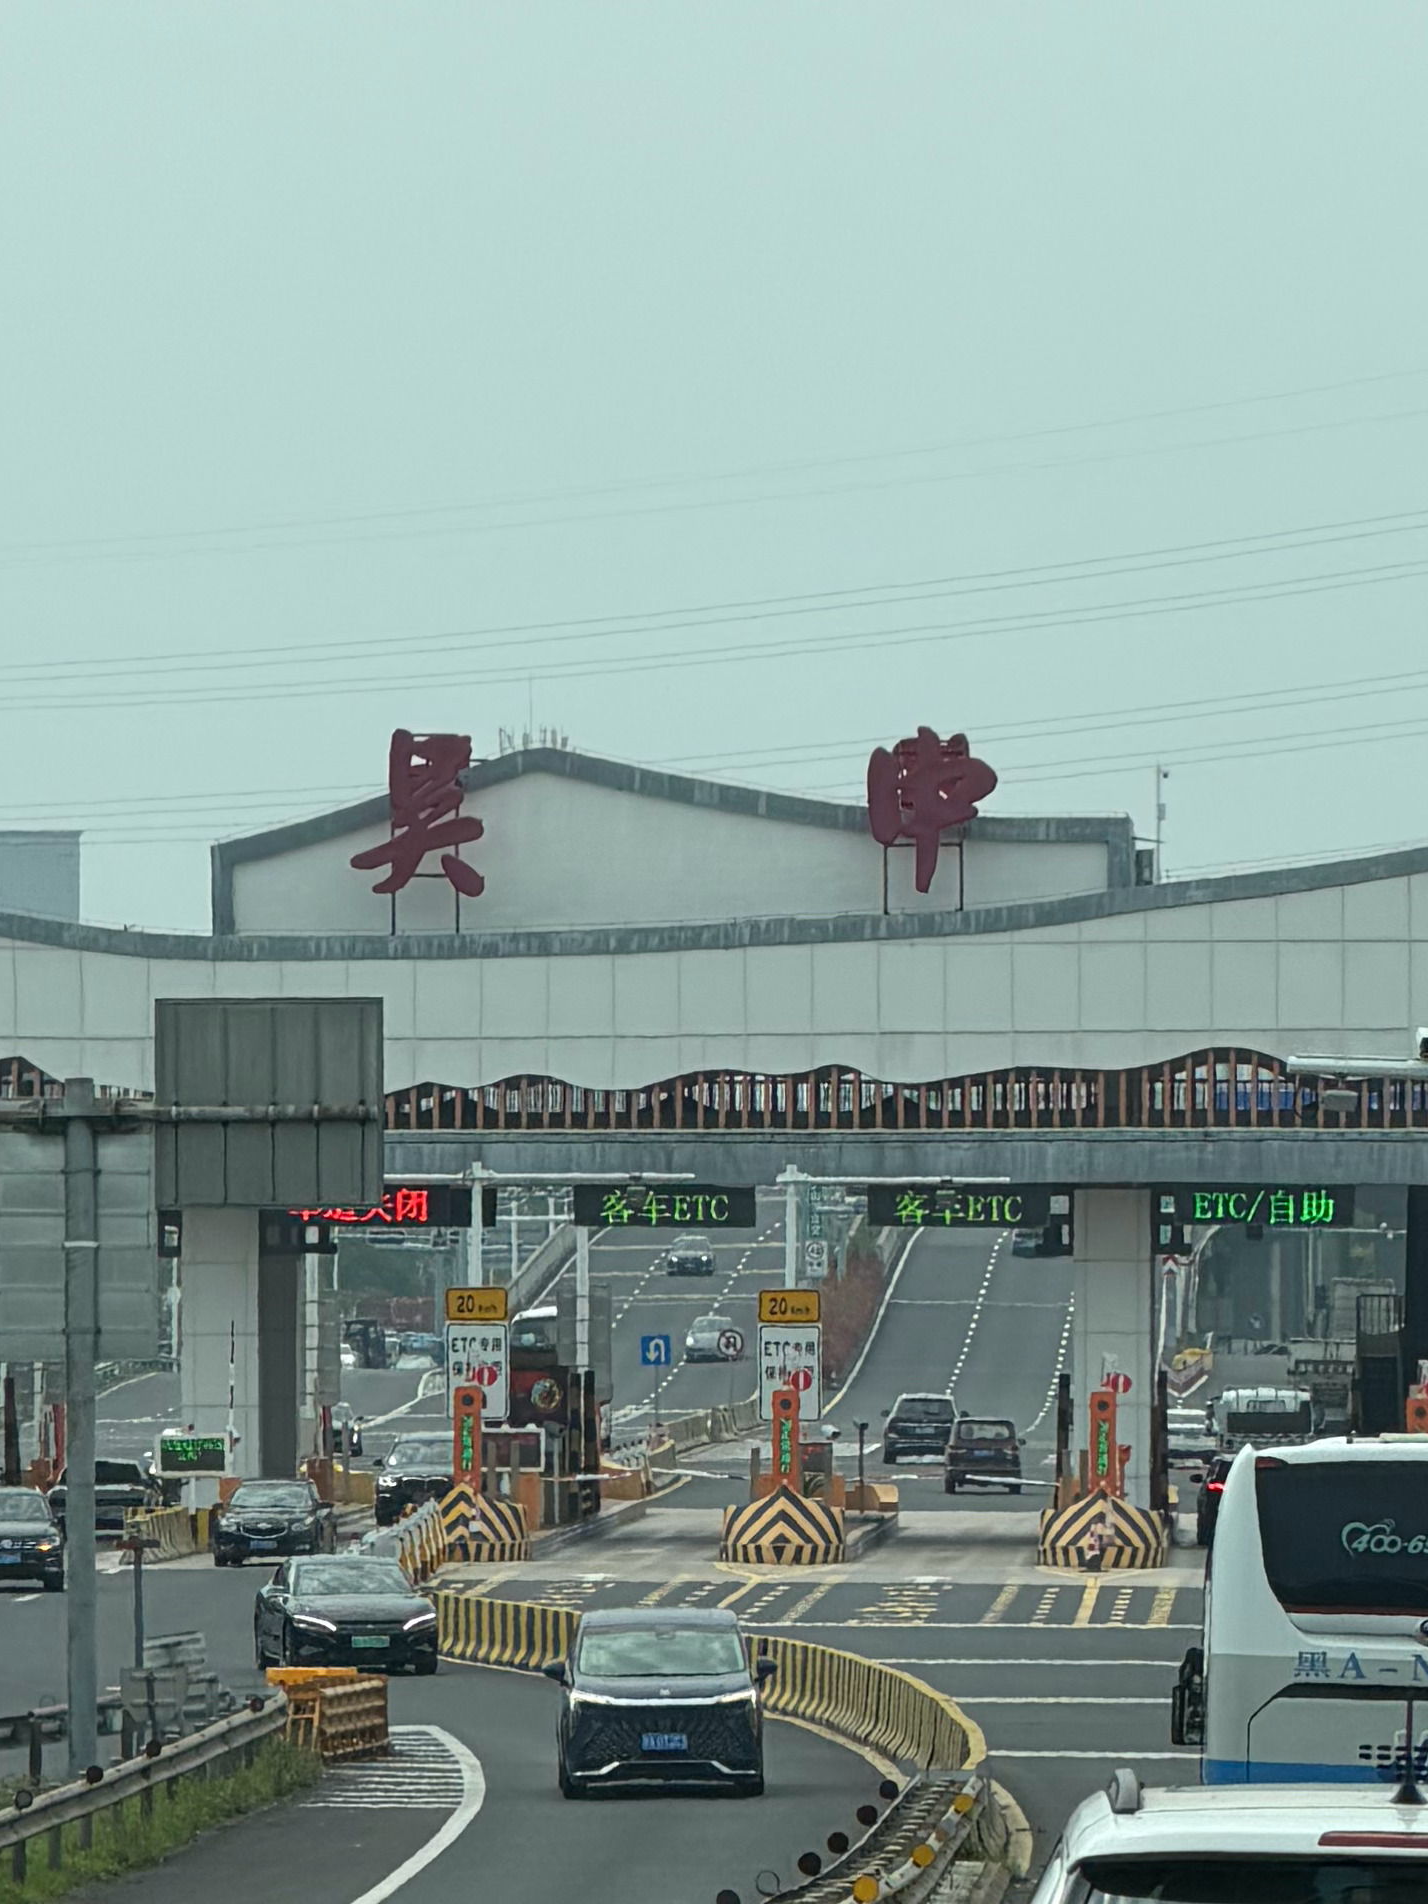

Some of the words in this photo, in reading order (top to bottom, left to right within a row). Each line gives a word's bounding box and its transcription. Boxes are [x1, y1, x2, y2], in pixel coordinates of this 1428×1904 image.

[1193, 1188, 1335, 1225] ETC/自助
[456, 1294, 475, 1313] 20
[769, 1297, 787, 1316] 20
